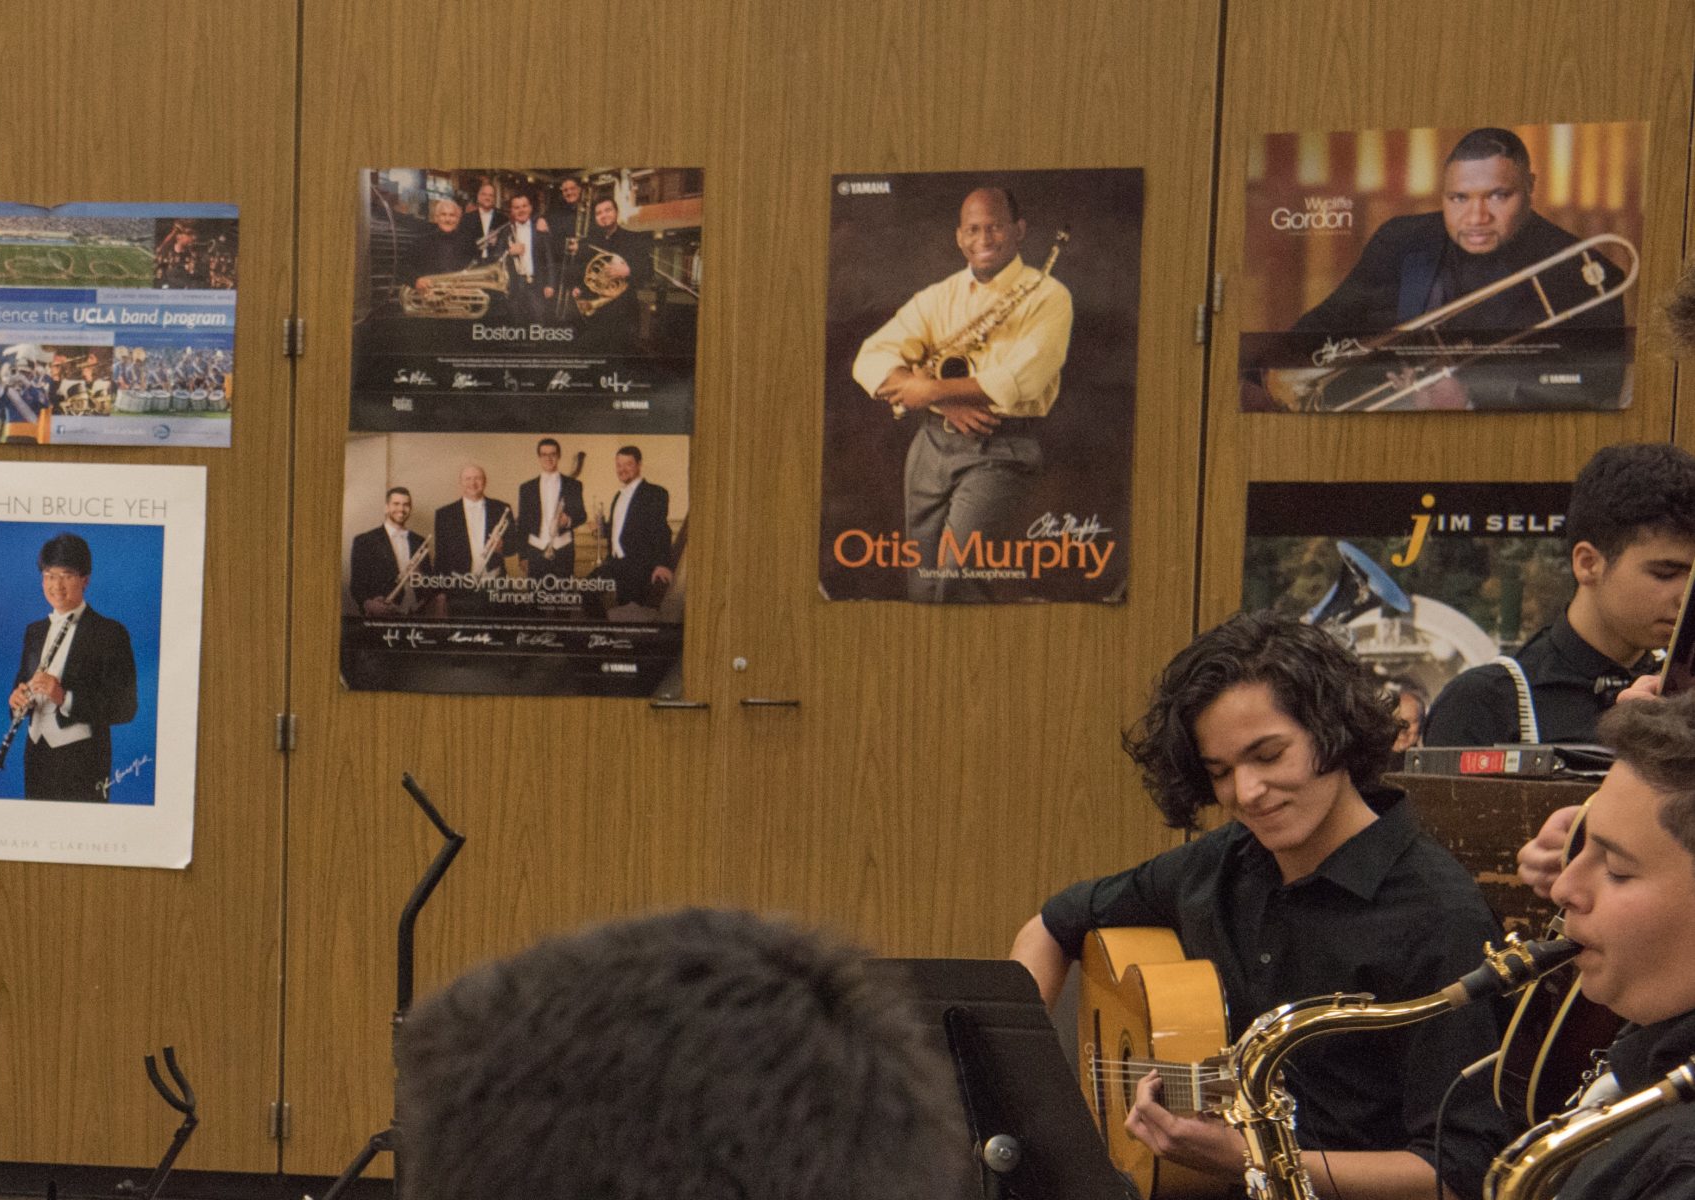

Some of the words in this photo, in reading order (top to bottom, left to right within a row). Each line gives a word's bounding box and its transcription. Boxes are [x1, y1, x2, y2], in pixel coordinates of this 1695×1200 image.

[850, 182, 891, 195] YAMAHA
[1271, 208, 1352, 231] Gordon
[42, 308, 68, 324] the
[73, 308, 116, 324] UCLA
[120, 308, 158, 325] band
[162, 310, 227, 329] program
[472, 324, 526, 342] Boston
[529, 325, 573, 342] Brass
[42, 496, 113, 518] BRUCE
[124, 497, 168, 519] YEH
[1486, 514, 1566, 532] SELF
[833, 529, 922, 569] Otis
[937, 531, 1116, 581] Murphy
[917, 567, 959, 579] Yamaha
[961, 567, 1027, 581] Saxophones
[410, 573, 464, 590] Boston
[463, 573, 543, 594] Symphony
[542, 573, 617, 592] Orchestra
[488, 589, 534, 605] Trumpet
[537, 591, 582, 605] Section
[49, 840, 129, 854] CLARINETS
